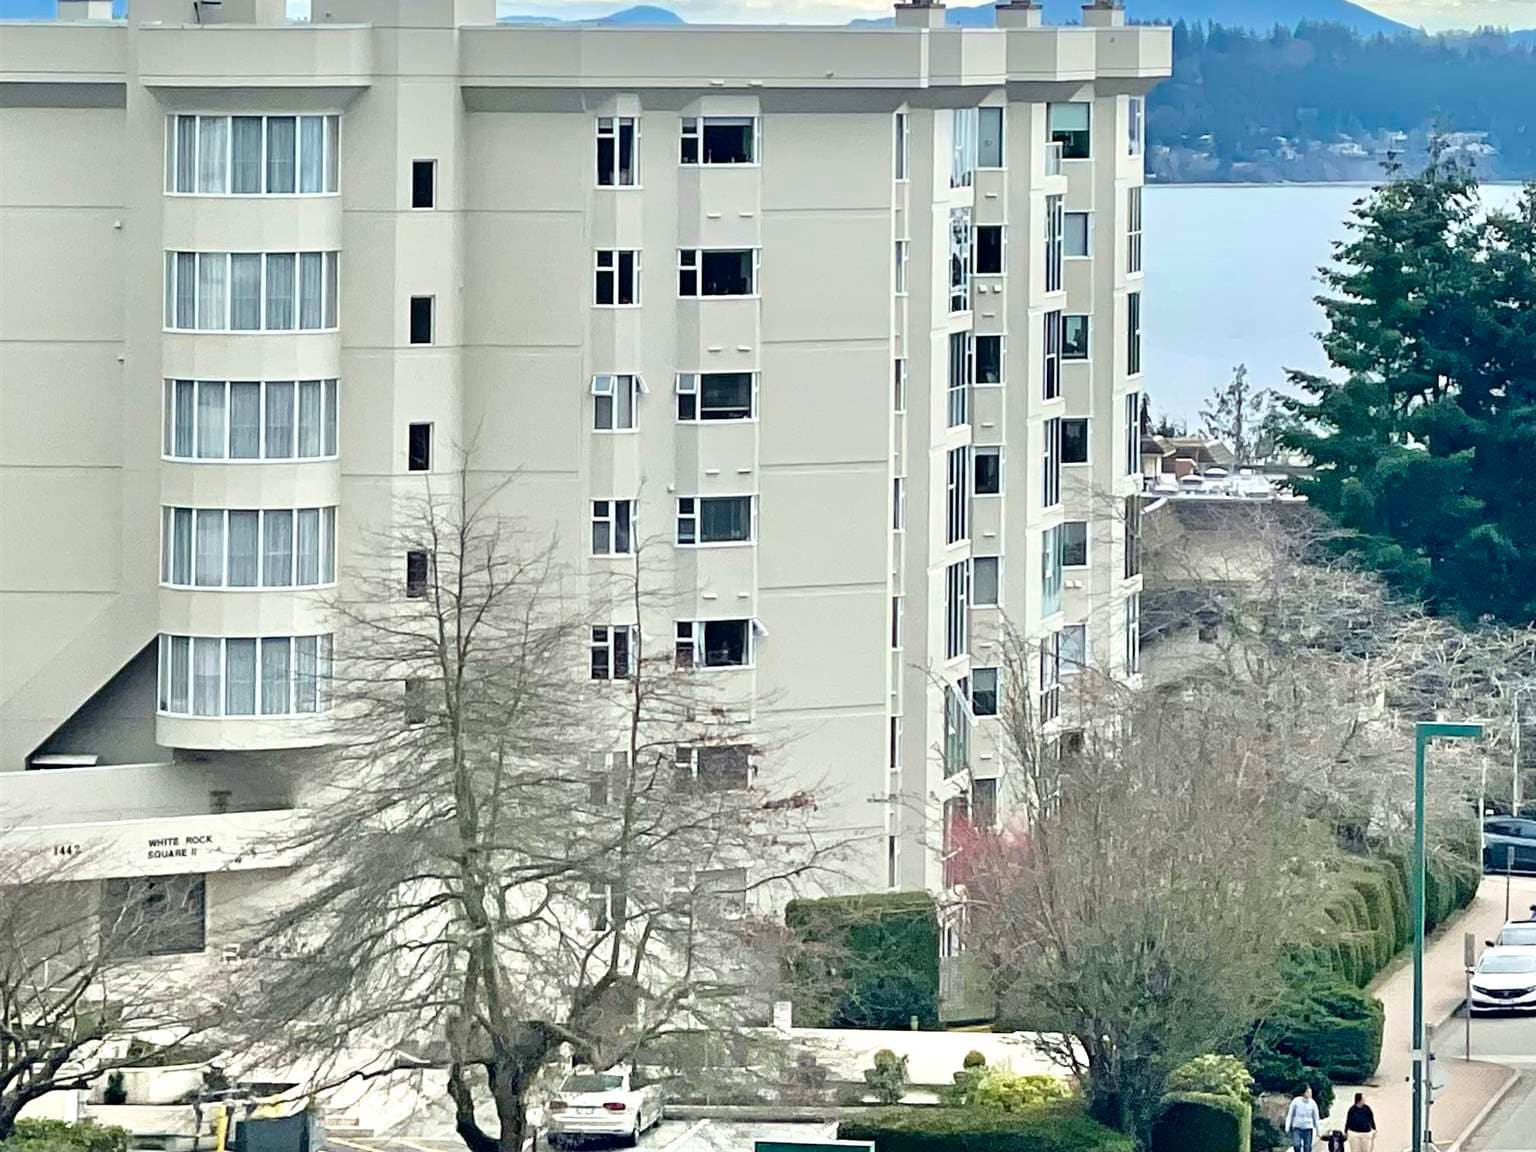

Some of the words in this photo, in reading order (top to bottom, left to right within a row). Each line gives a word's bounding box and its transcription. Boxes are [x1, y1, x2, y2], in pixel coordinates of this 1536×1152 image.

[148, 837, 179, 847] WHITE
[185, 835, 213, 844] ROCK
[147, 848, 187, 859] SQUARE
